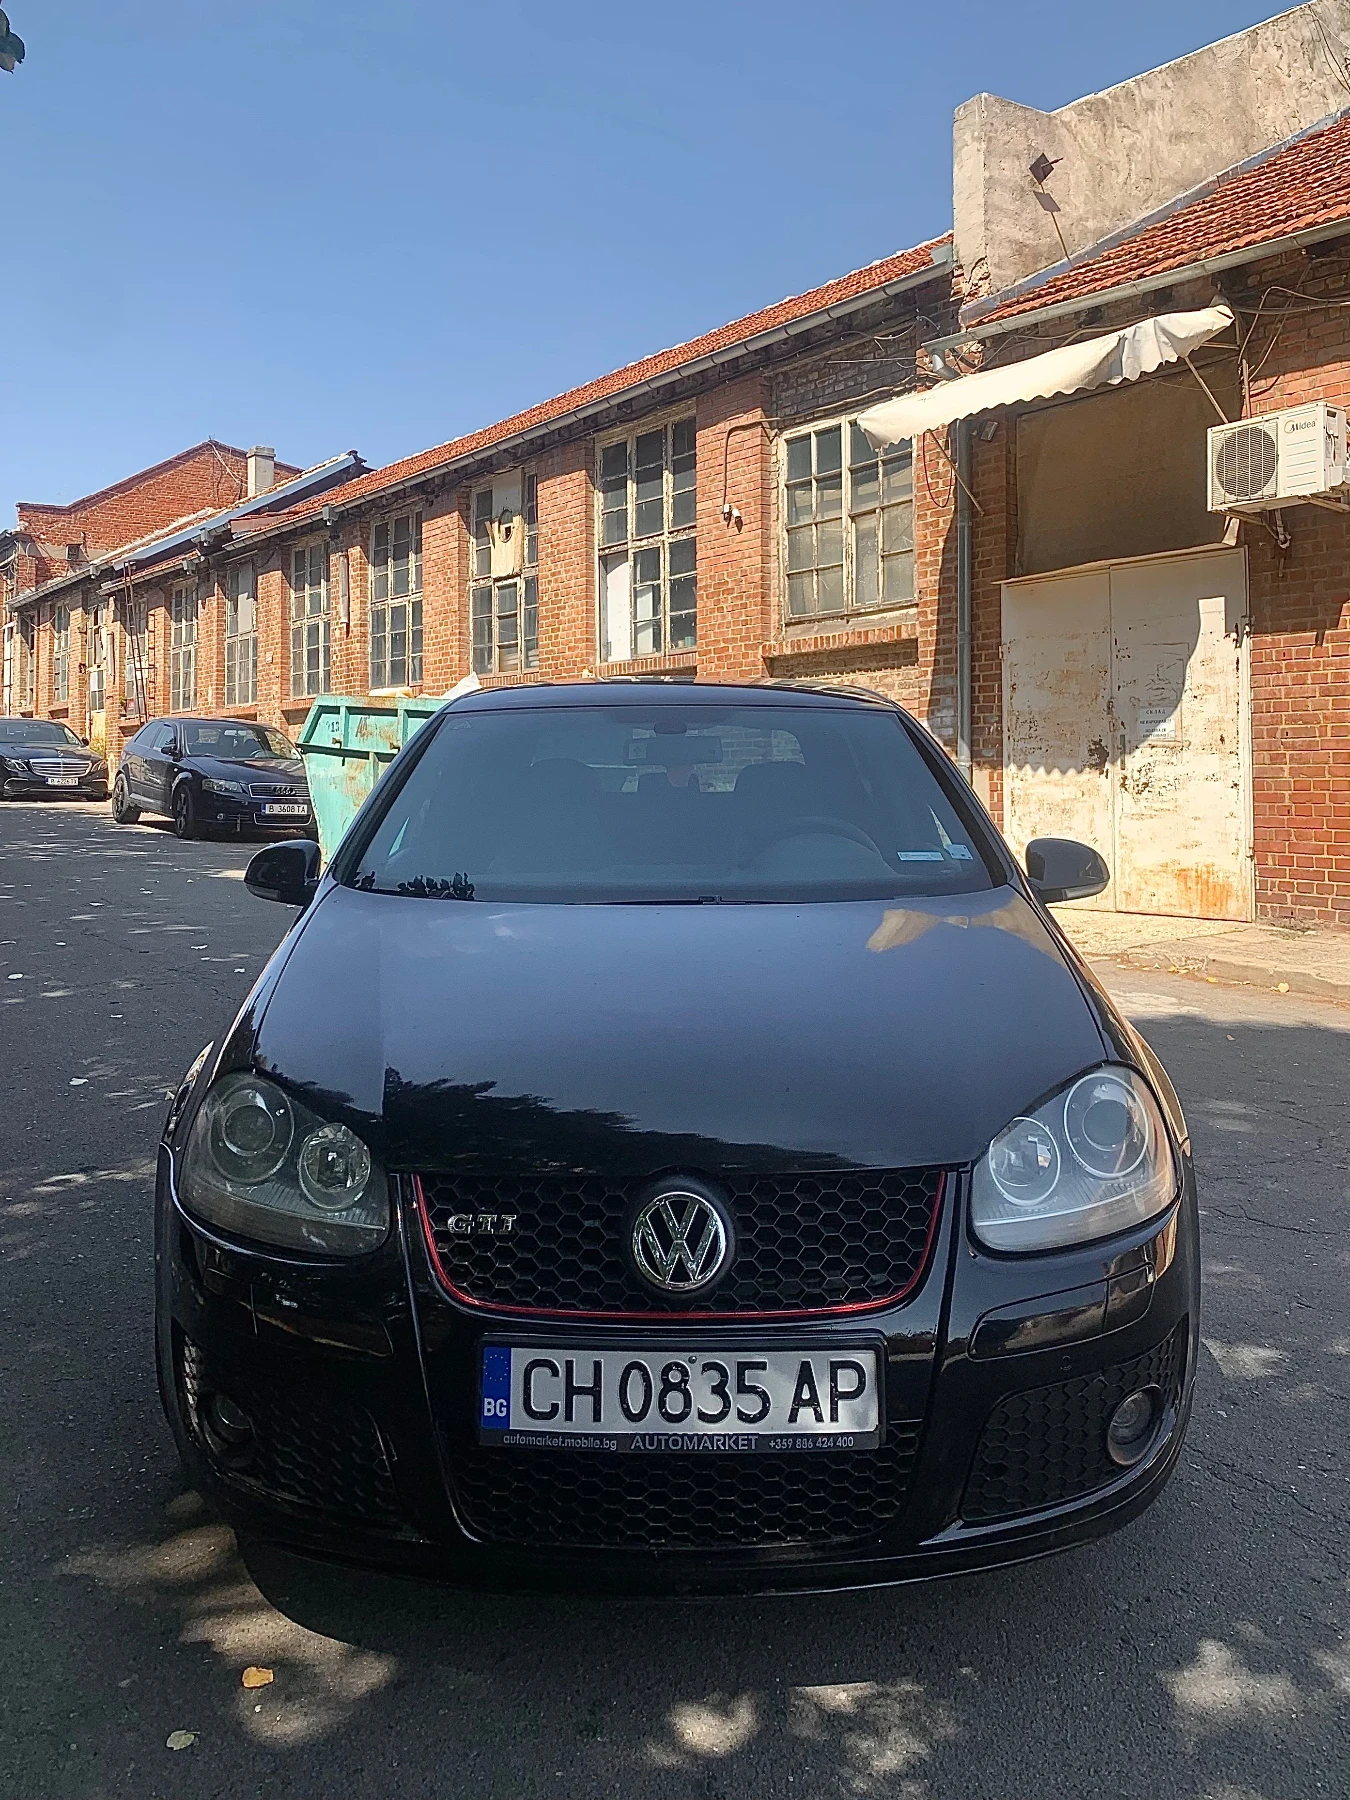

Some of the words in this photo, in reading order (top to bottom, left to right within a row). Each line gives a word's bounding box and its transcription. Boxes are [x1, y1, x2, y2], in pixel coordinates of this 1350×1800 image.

[1284, 420, 1316, 434] Midea
[269, 805, 274, 813] B
[277, 805, 296, 813] 3608
[296, 805, 306, 814] TA
[447, 1213, 517, 1235] GTI
[522, 1358, 601, 1423] CH
[618, 1359, 771, 1424] 0835
[787, 1359, 867, 1424] AP
[483, 1398, 507, 1417] BG
[503, 1433, 618, 1450] automarket.mobile.bg
[630, 1435, 759, 1450] AUTOMARKET
[768, 1437, 793, 1449] +359
[795, 1437, 814, 1449] 886
[815, 1437, 834, 1448] 424
[836, 1436, 854, 1447] 400
